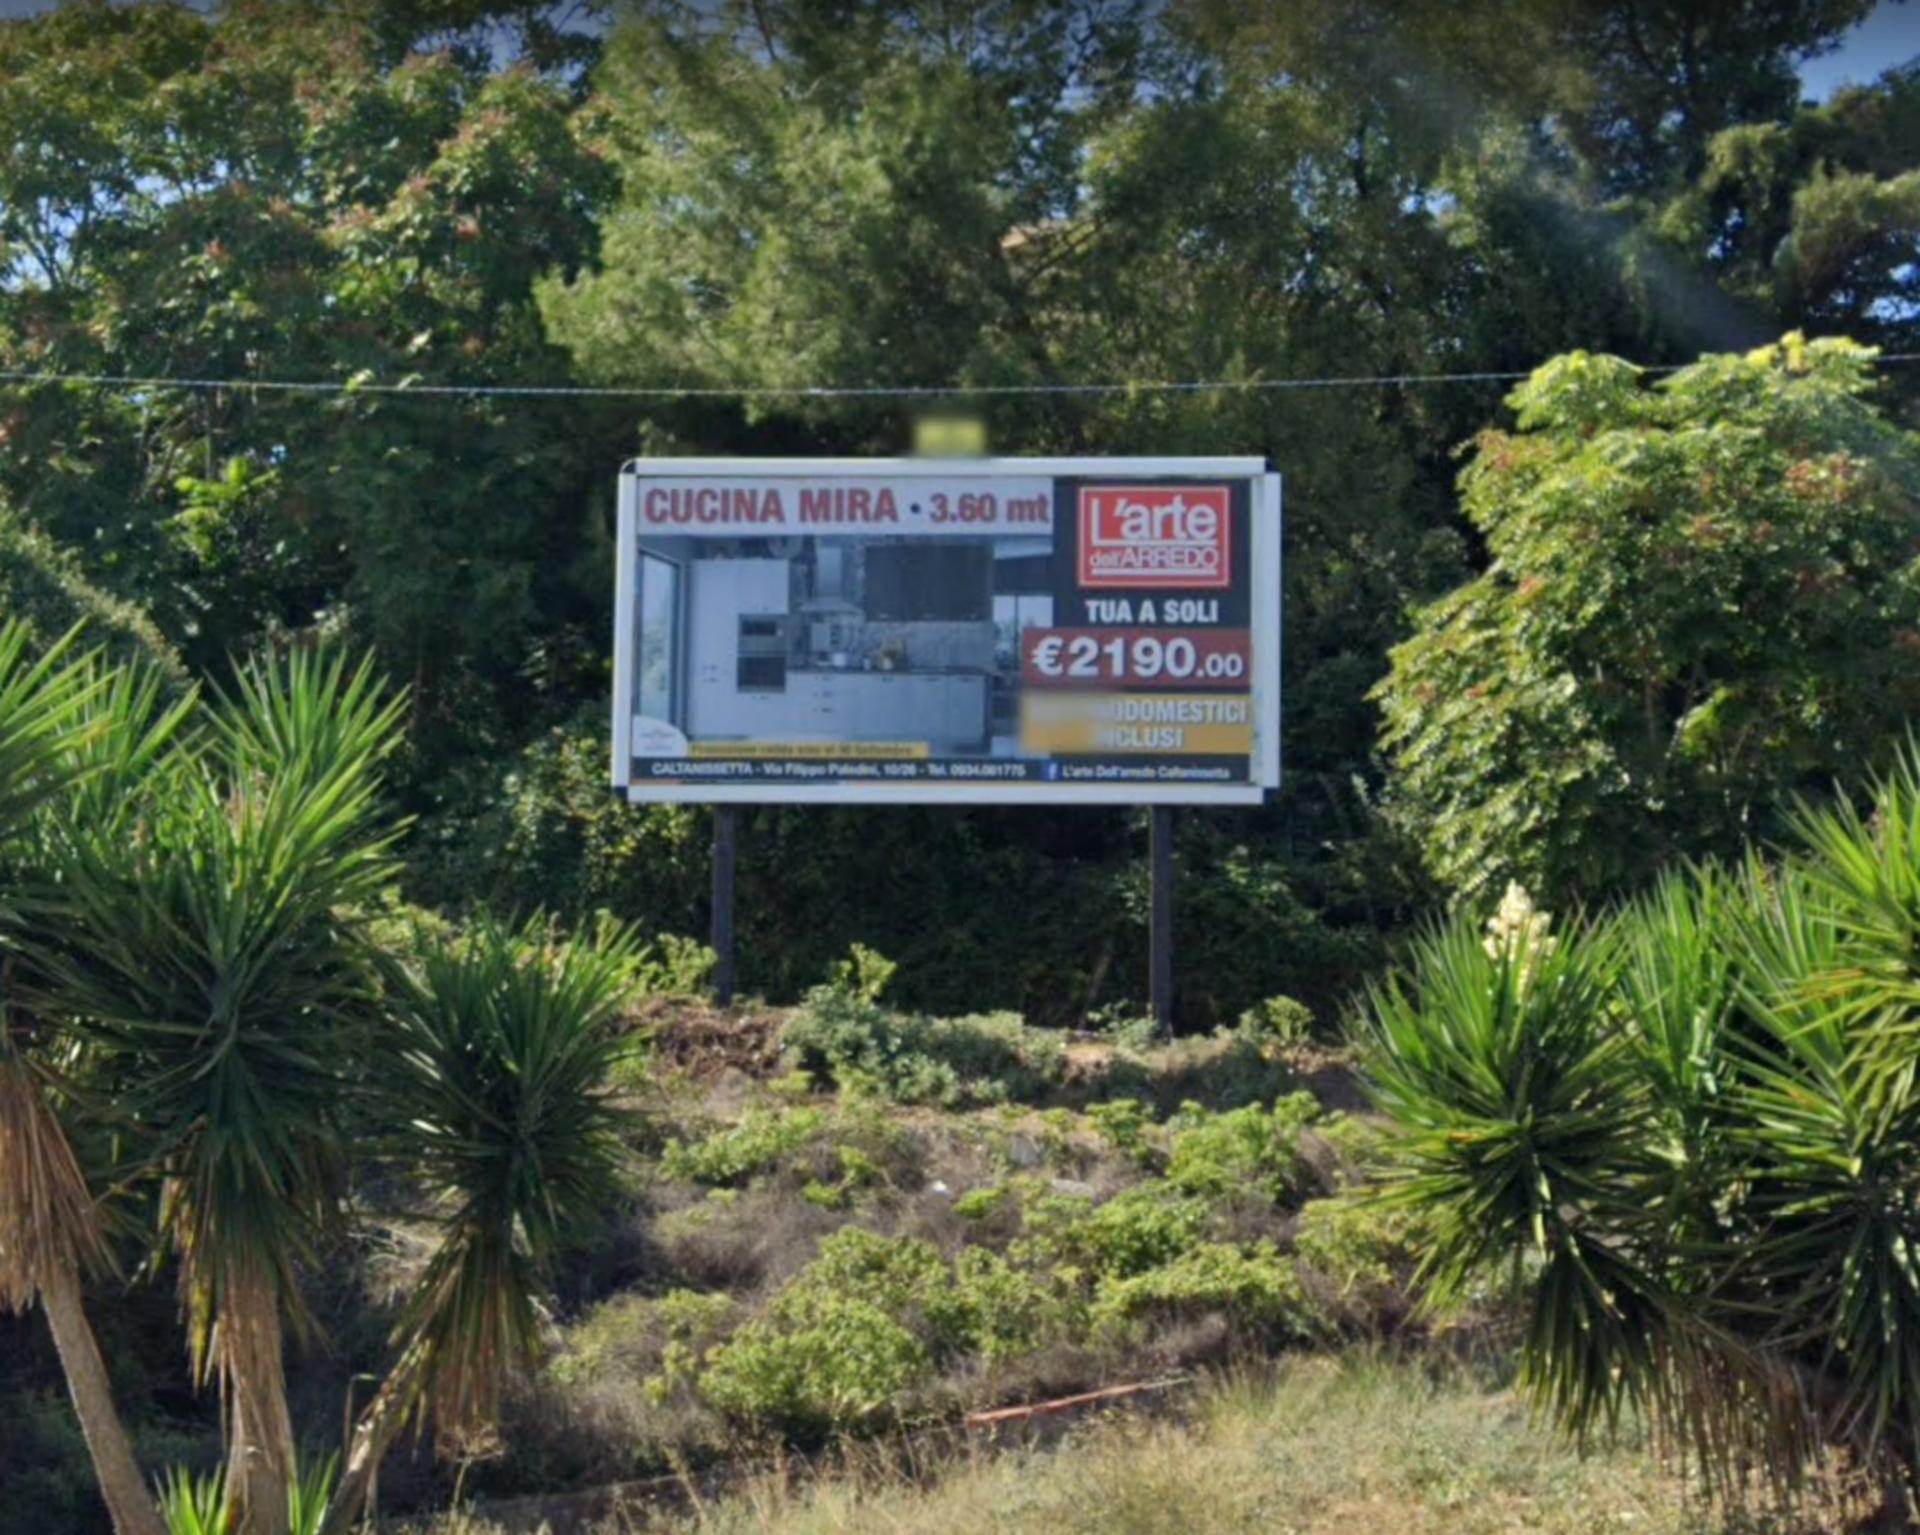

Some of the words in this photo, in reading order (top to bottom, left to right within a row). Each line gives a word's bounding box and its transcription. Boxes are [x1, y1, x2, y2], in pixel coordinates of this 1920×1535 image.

[644, 488, 785, 524] CUCINA
[798, 487, 899, 523] MIRA
[929, 493, 998, 523] 3.60
[1005, 492, 1050, 523] mt
[1090, 494, 1218, 547] L'arte
[1089, 547, 1219, 568] dell'ARREDO
[1085, 599, 1133, 623] TUA
[1138, 599, 1157, 623] A
[1163, 599, 1219, 623] SOLI
[1031, 634, 1244, 678] €2190.00
[762, 762, 784, 775] Via
